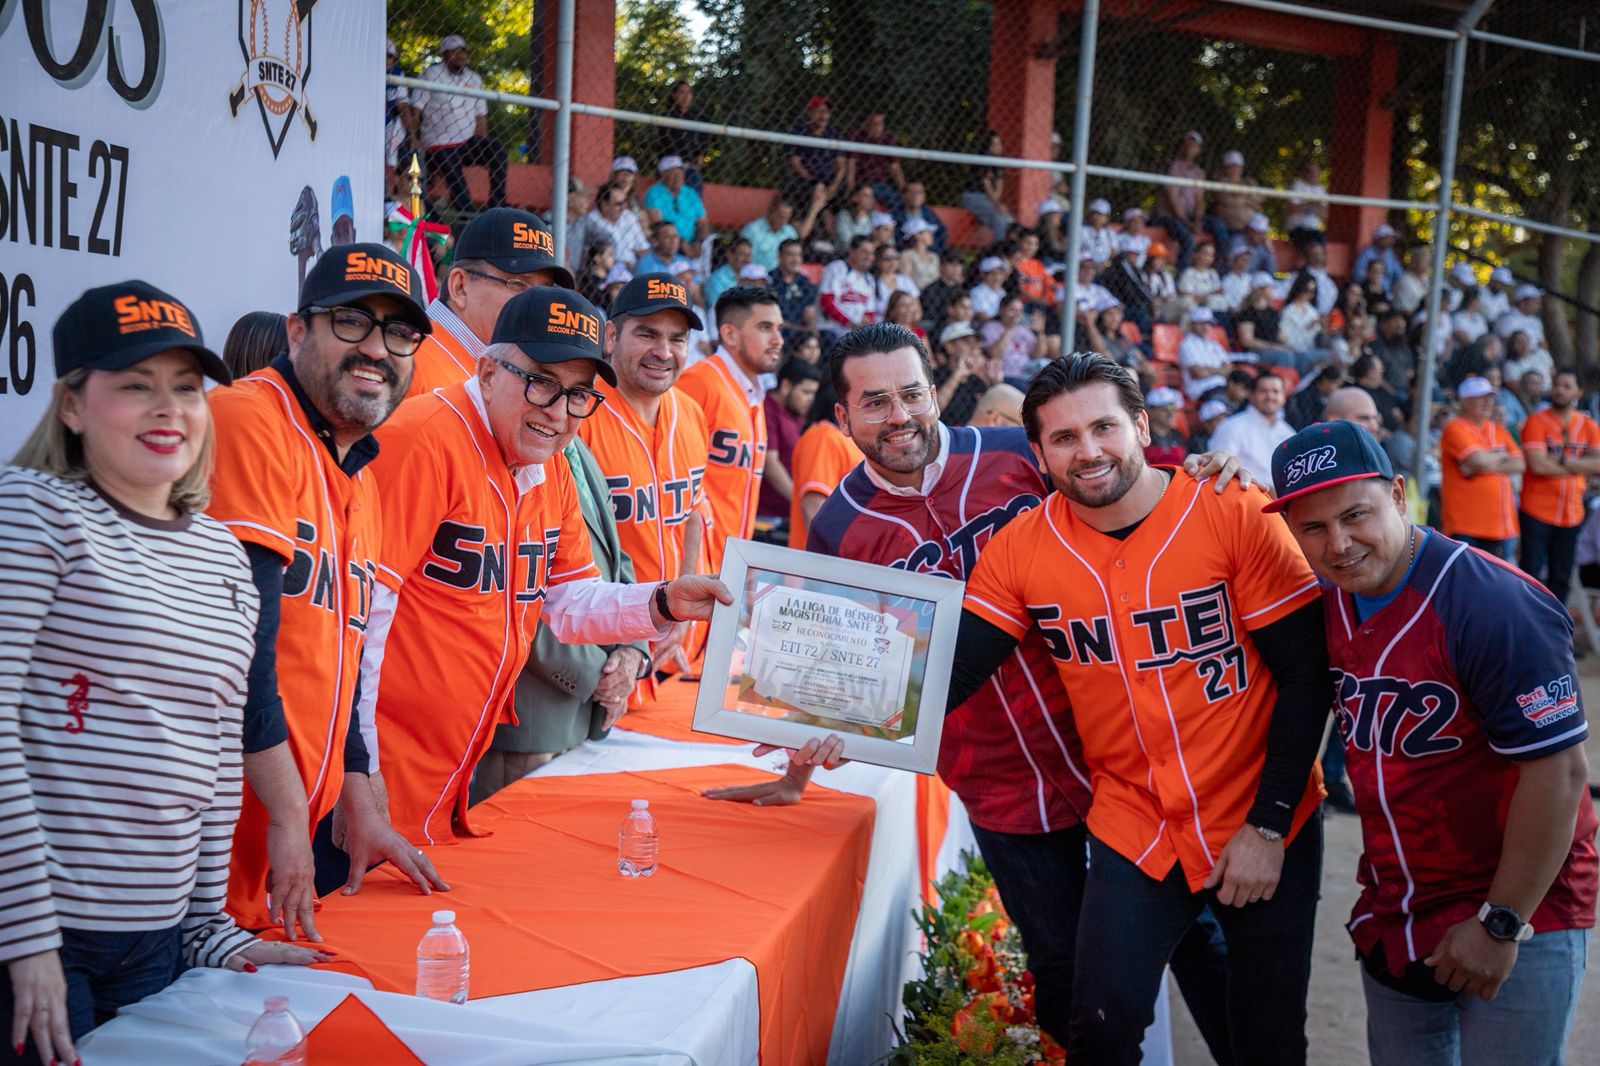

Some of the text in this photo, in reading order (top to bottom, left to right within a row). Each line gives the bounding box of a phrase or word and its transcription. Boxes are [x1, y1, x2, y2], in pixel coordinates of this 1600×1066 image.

[259, 61, 296, 92] SNTE 27
[88, 139, 129, 257] 27
[513, 222, 553, 255] SNTE
[345, 252, 408, 289] SNTE
[648, 279, 686, 302] SNTE
[113, 295, 195, 333] SNTE
[549, 302, 598, 339] SNTE
[281, 518, 375, 619] SNT
[779, 606, 843, 625] MAGISTERIAL
[848, 620, 873, 633] SNTE
[875, 625, 889, 635] 27
[787, 598, 800, 608] LA
[803, 600, 825, 613] LIGA
[828, 605, 841, 616] DE
[1026, 590, 1229, 665] SNTE
[804, 644, 818, 658] 72
[821, 648, 828, 660] /
[830, 650, 865, 666] SNTE
[866, 656, 881, 669] 27
[1196, 643, 1249, 705] 27
[1517, 674, 1573, 706] SNTE 27
[1534, 705, 1579, 728] SINALOA
